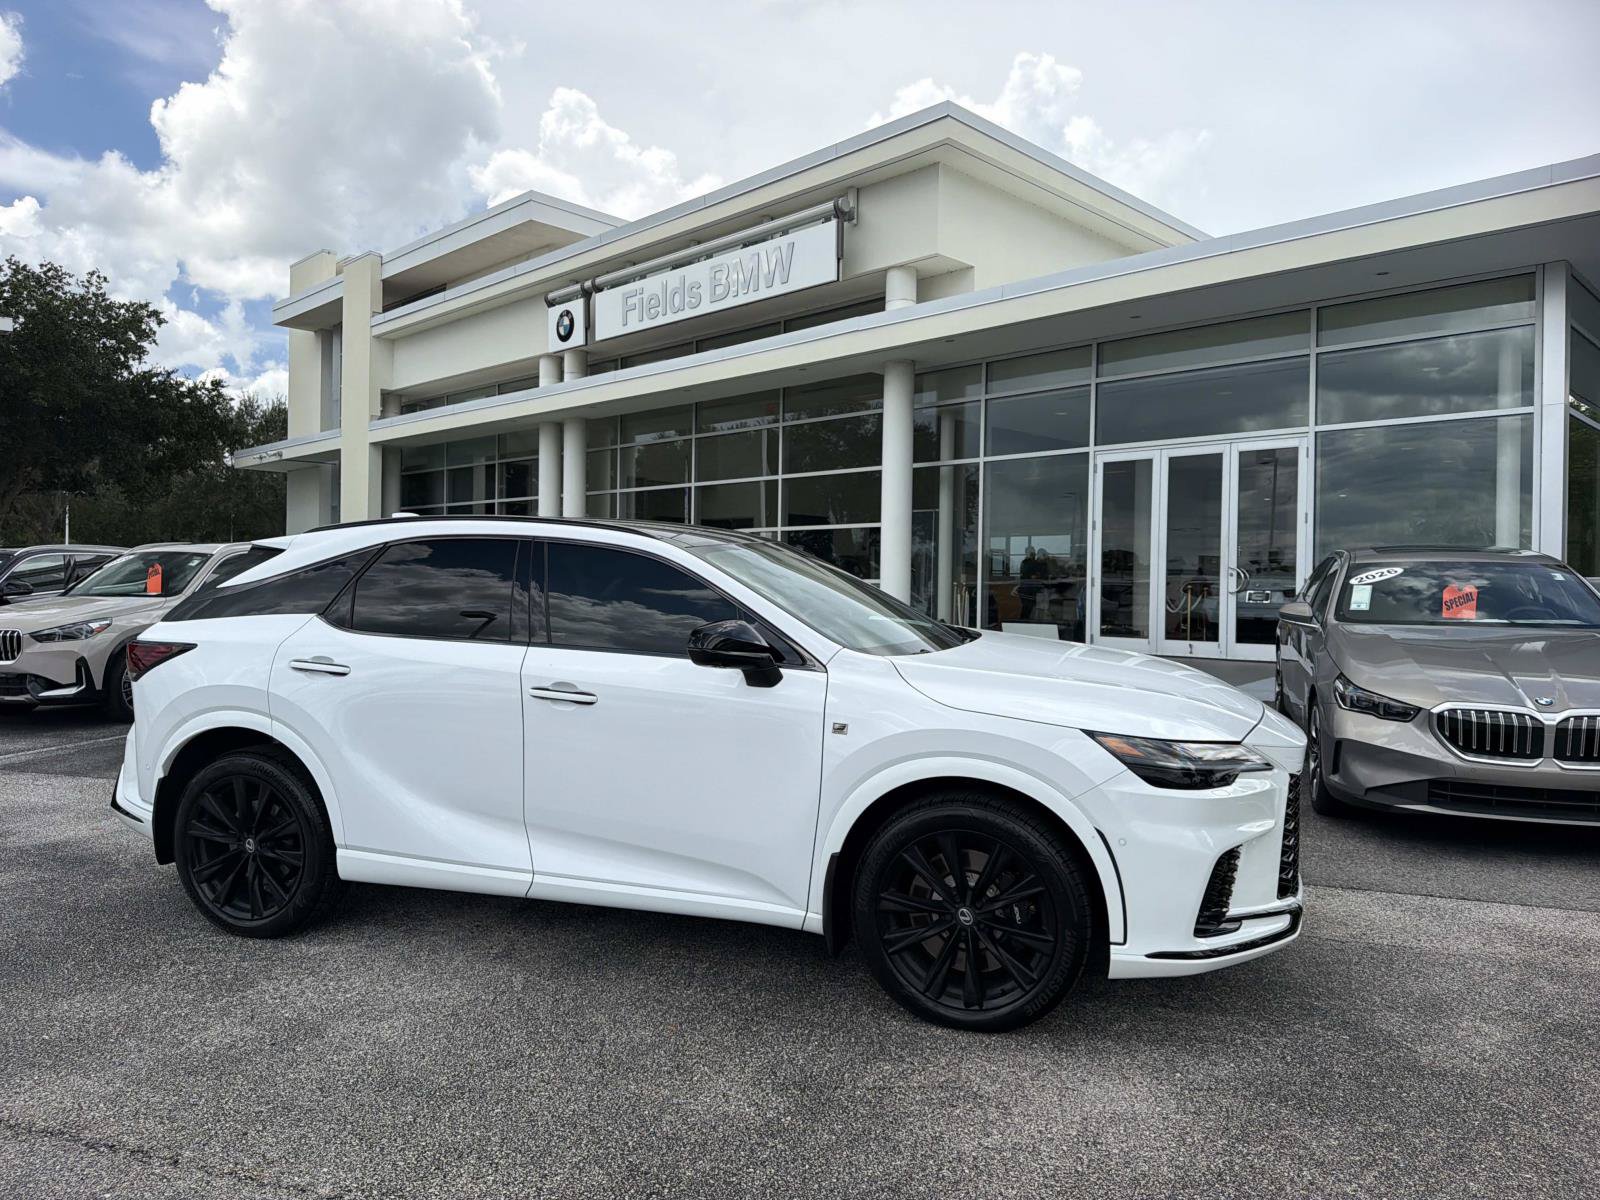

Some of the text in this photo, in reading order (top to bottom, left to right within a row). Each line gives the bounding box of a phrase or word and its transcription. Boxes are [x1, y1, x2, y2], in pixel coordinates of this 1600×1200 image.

[621, 240, 796, 327] Fields BMW
[1443, 591, 1476, 611] SPECIAL
